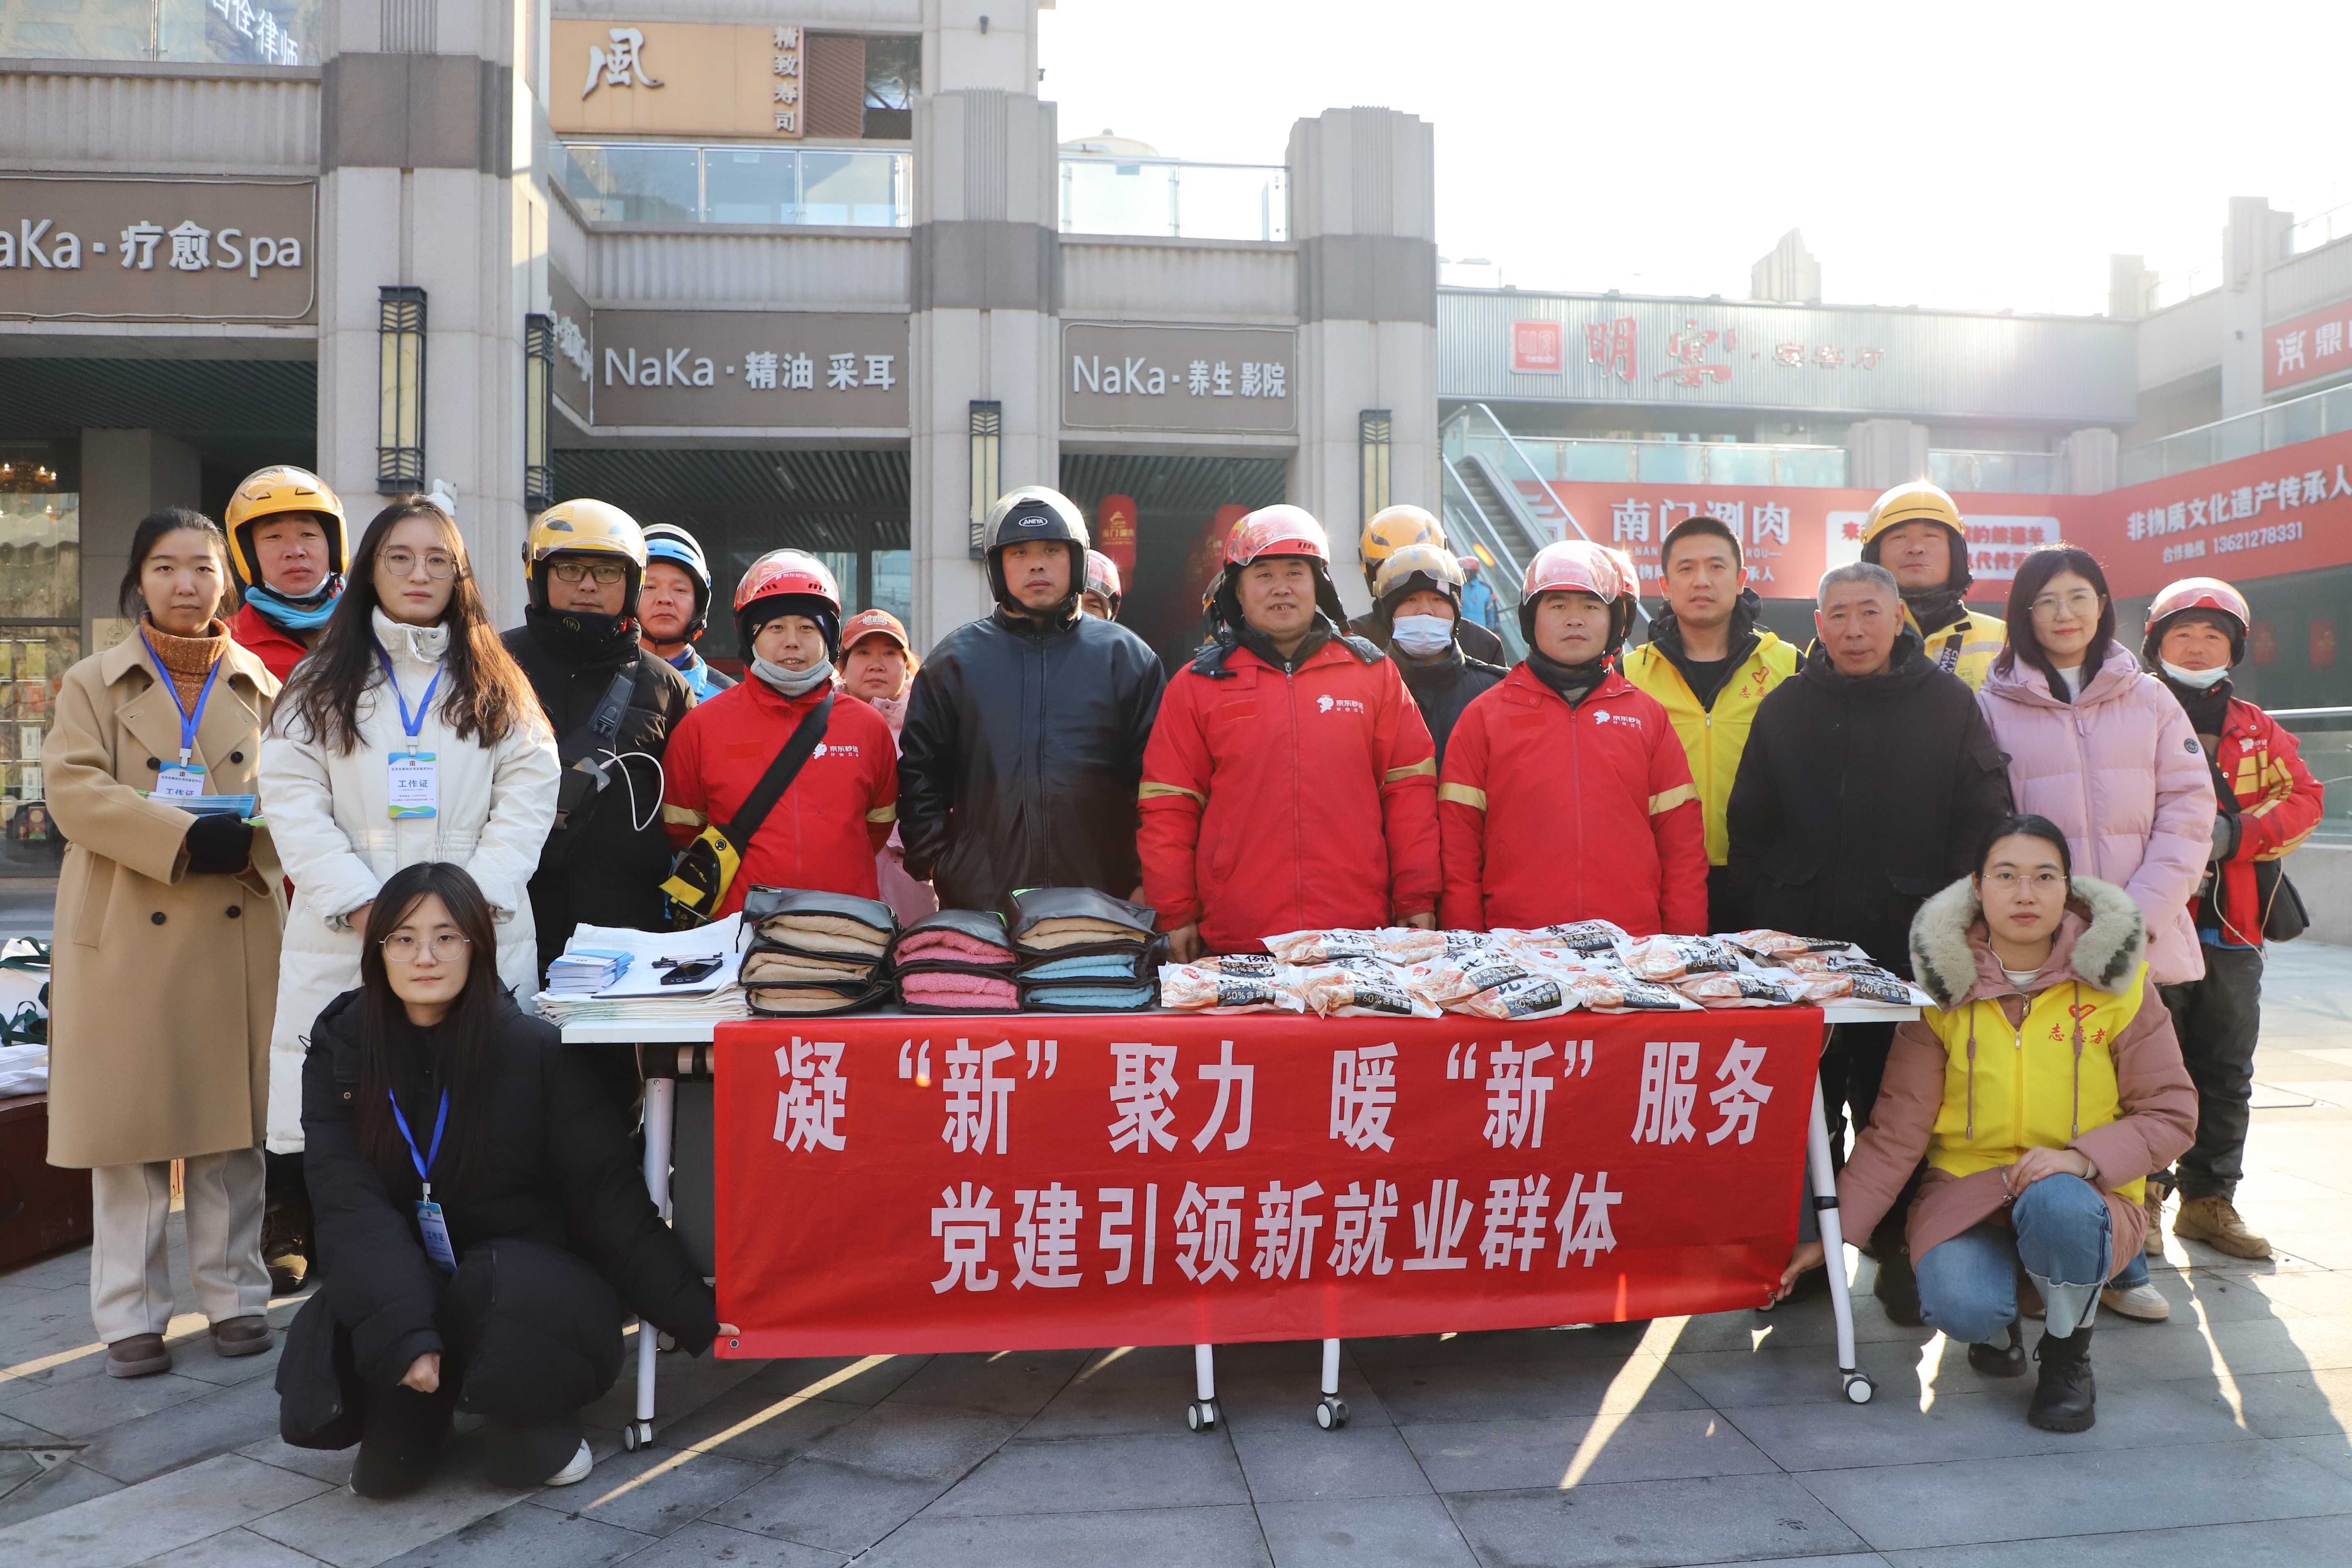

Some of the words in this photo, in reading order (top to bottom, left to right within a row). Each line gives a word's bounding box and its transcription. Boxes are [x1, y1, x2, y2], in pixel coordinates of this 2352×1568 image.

[774, 27, 798, 132] 精致寿司
[2127, 464, 2352, 540] 非物质文化遗产传承人
[1634, 546, 1658, 557] NAN
[2213, 521, 2303, 554] 13621278331
[829, 745, 858, 753] 京东秒送
[165, 788, 195, 796] 工作证
[398, 779, 428, 788] 工作证
[773, 1036, 848, 1153] 凝
[1107, 1039, 1255, 1154] 聚力
[1329, 1041, 1399, 1153] 暖
[1631, 1038, 1774, 1146] 服务
[931, 1171, 1623, 1294] 党建引领新就业群体
